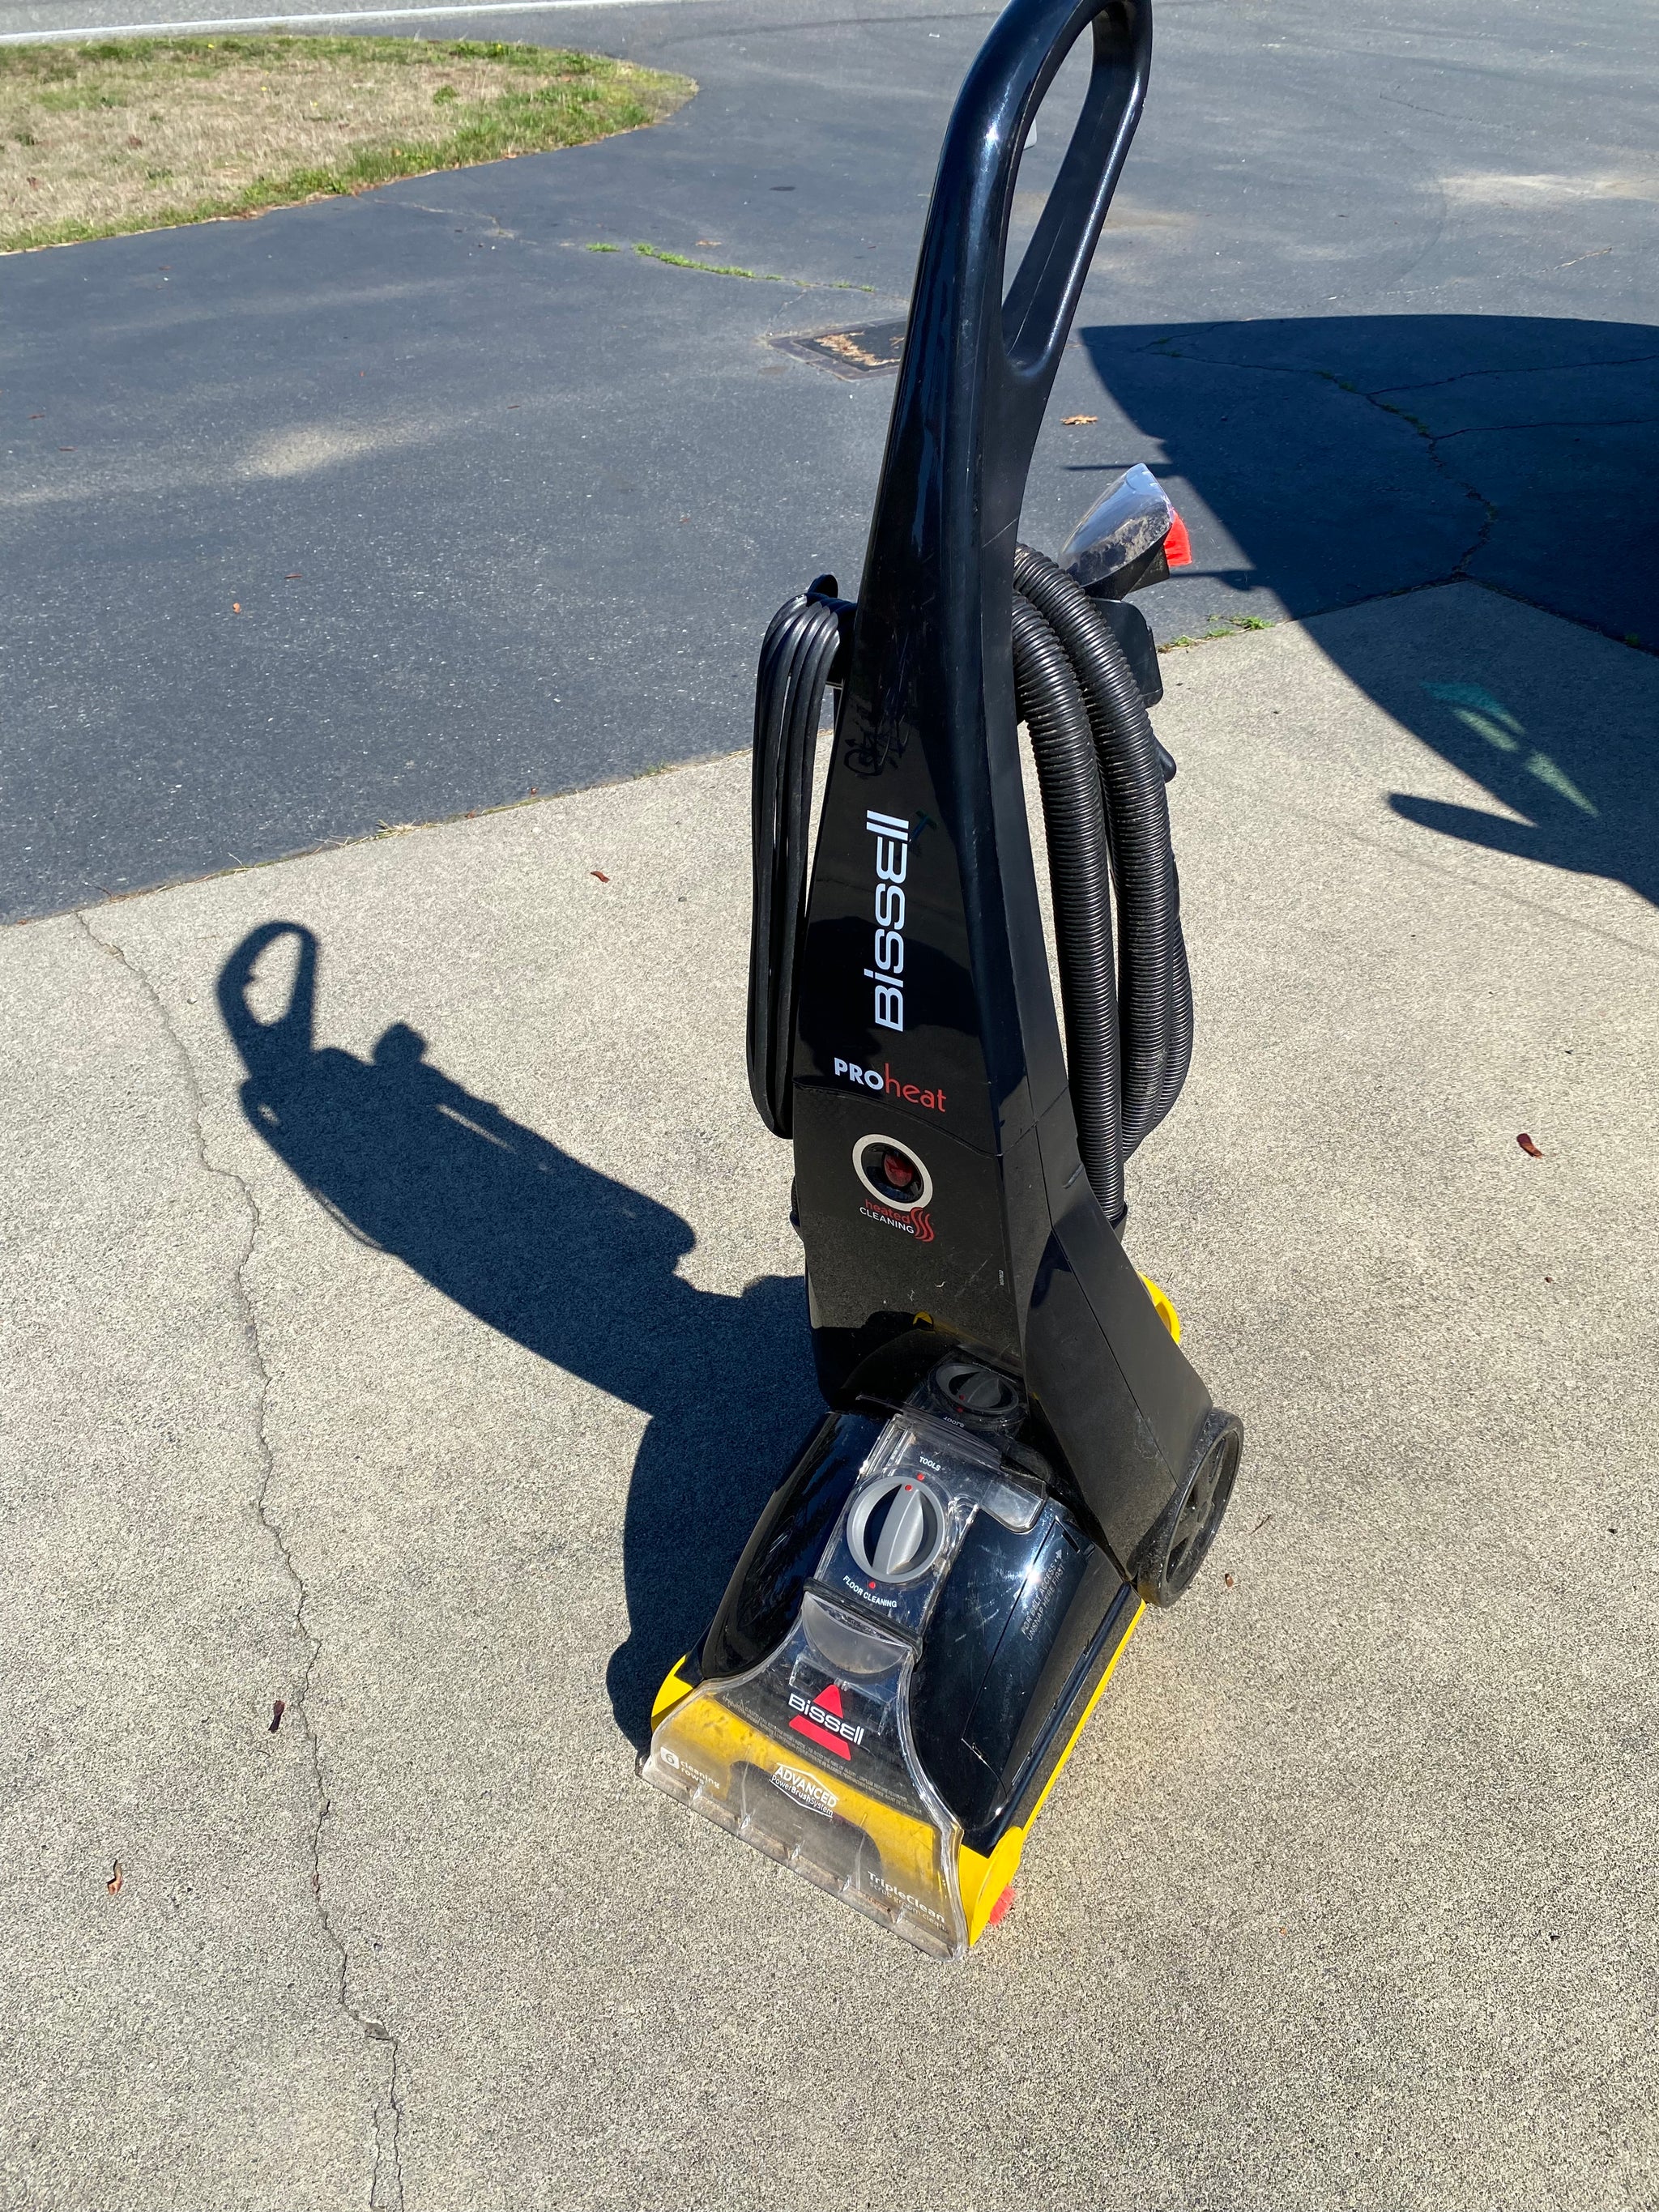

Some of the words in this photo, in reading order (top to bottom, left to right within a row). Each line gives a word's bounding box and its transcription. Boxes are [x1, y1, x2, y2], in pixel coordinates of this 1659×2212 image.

[834, 1056, 947, 1113] PROheat
[859, 1206, 915, 1234] CLEANING
[864, 1199, 911, 1224] heated
[919, 1455, 941, 1472] TOOLS
[842, 1575, 864, 1596] FLOOR
[863, 1592, 898, 1608] CLEANING
[1021, 1614, 1034, 1634] FOR
[1029, 1594, 1043, 1617] BELT
[1038, 1562, 1056, 1596] ACCESS
[1026, 1607, 1045, 1642] UNSNAP
[1042, 1584, 1056, 1608] HERE
[1051, 1563, 1066, 1586] FIRST
[680, 1760, 720, 1789] cleaning
[774, 1765, 837, 1808] ADVANCED
[867, 1870, 945, 1924] TripleClean
